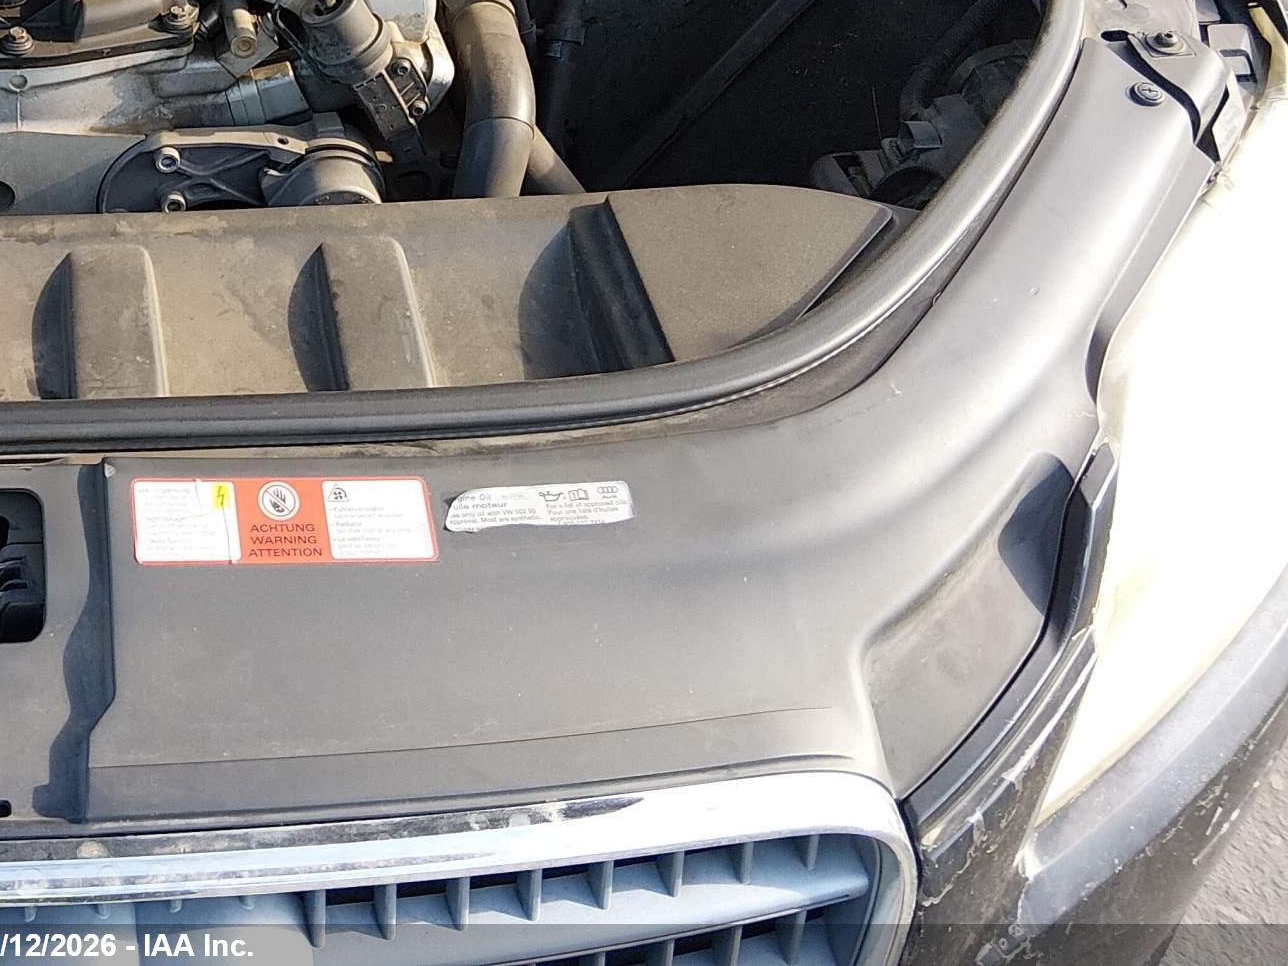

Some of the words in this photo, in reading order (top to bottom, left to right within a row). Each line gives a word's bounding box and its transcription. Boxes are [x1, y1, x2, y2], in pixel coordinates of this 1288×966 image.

[250, 523, 316, 533] ACHTUNG
[250, 535, 318, 545] WARNING
[248, 547, 323, 557] ATTENTION
